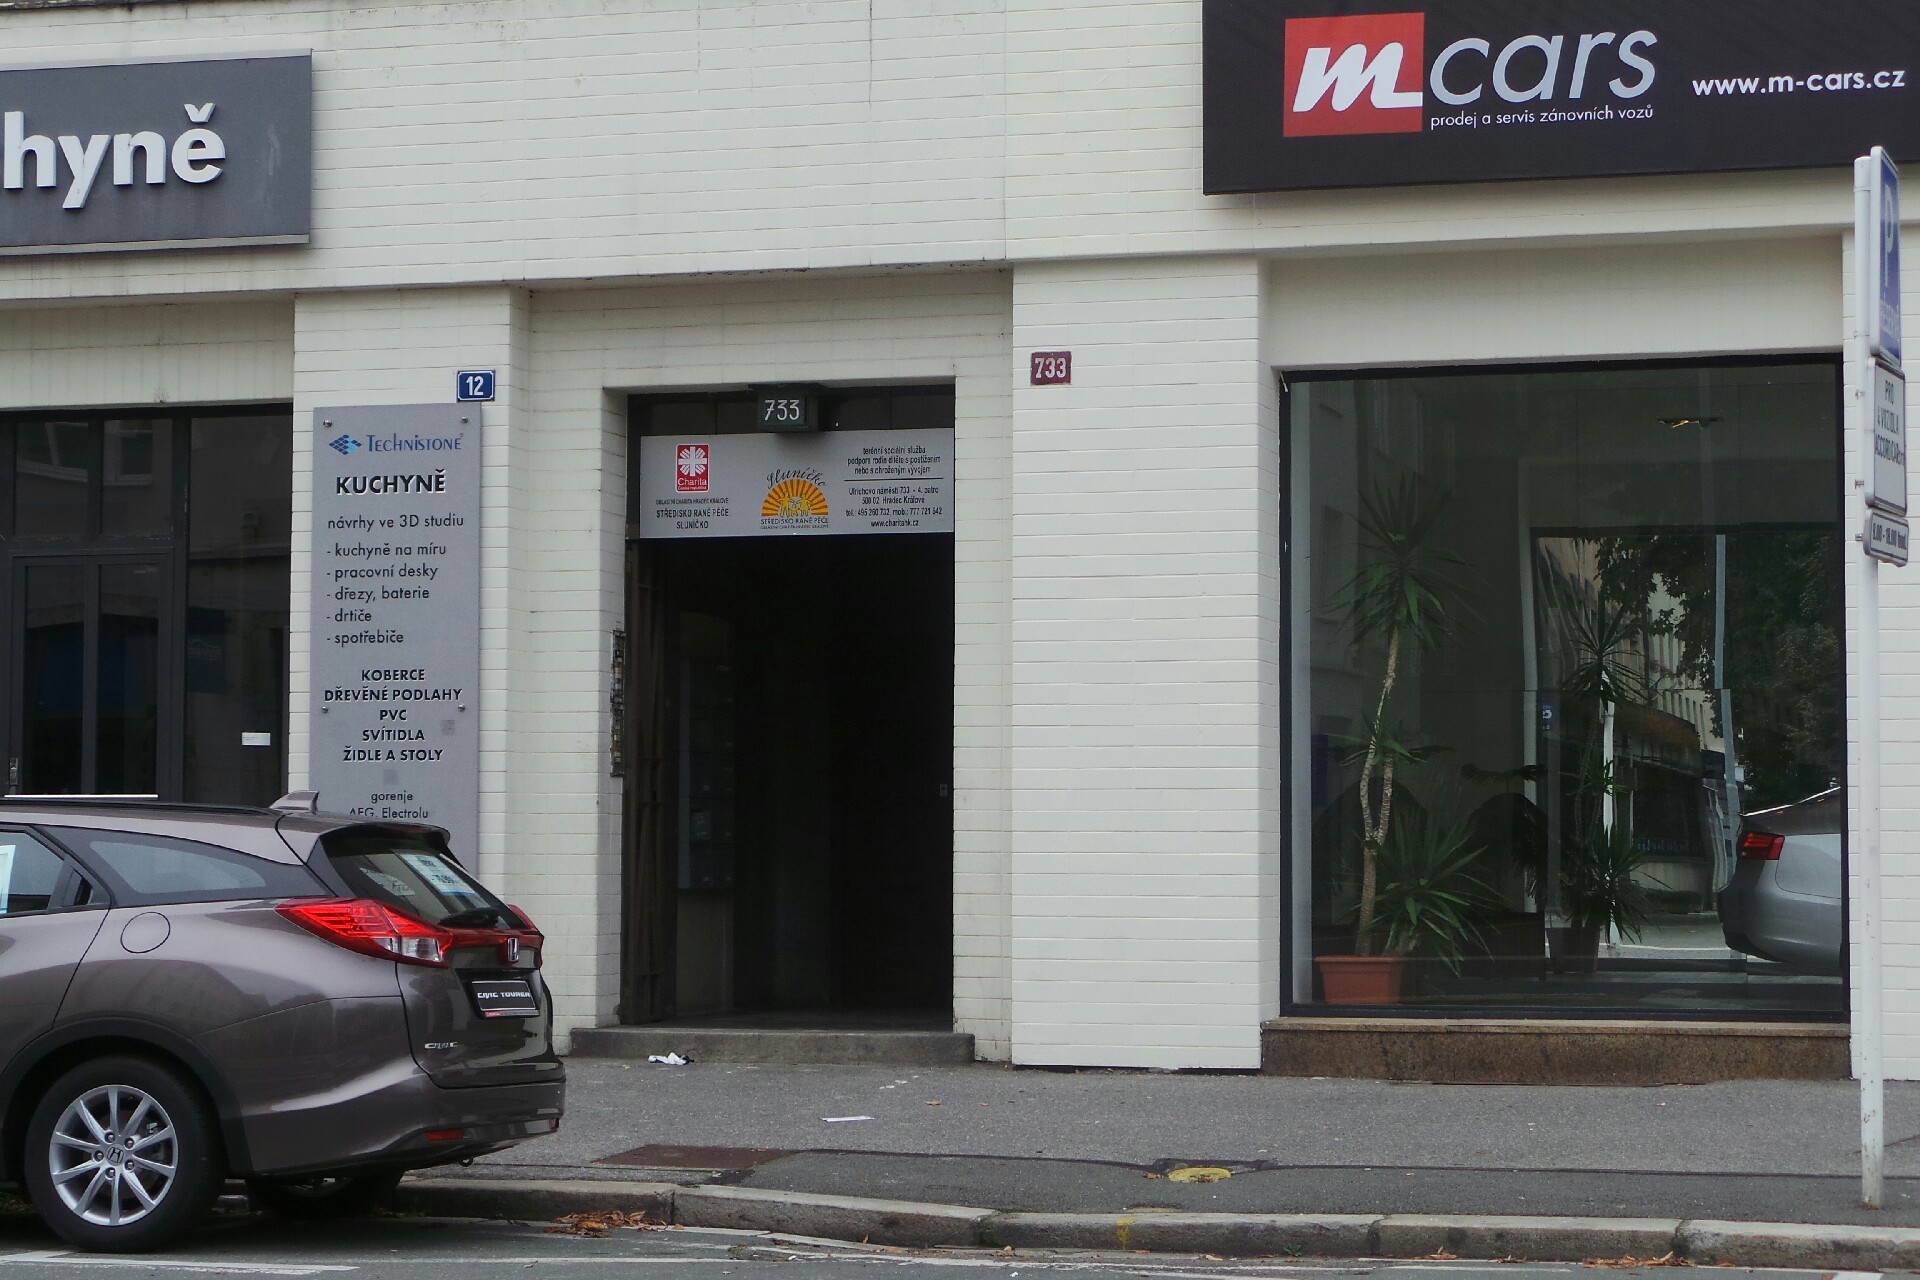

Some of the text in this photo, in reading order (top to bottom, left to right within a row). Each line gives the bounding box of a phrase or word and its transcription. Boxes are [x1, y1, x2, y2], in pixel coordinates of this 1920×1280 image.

[1430, 30, 1658, 106] cars
[1692, 70, 1905, 96] www.m-cars.cz
[1431, 104, 1654, 130] prodej a servis zánovních vozů
[3, 102, 226, 209] hyně
[1884, 183, 1894, 287] P
[1035, 358, 1066, 378] 733
[466, 376, 484, 396] 12
[764, 400, 800, 420] 733
[336, 468, 446, 495] KUCHYNĚ
[656, 507, 728, 518] STŘEDISKO RANÉ PÉČE
[328, 513, 464, 532] návrhy ve 3D studiu
[336, 544, 390, 560] kuchyně
[396, 546, 412, 556] na
[418, 542, 446, 556] míru
[335, 565, 394, 582] pracovní
[398, 563, 438, 580] desky
[335, 586, 376, 602] dřezy,
[382, 586, 430, 599] baterie
[335, 608, 372, 622] drtiče
[335, 630, 404, 647] spotřebiče
[362, 669, 425, 682] KOBERCE
[324, 686, 462, 701] DŘEVĚNÉ PODLAHY
[380, 710, 407, 720] PVC
[362, 726, 425, 741] SVÍTIDLA
[343, 746, 443, 762] ŽIDLE A STOLY
[371, 790, 413, 804] gorenje
[382, 807, 428, 818] Electrolu
